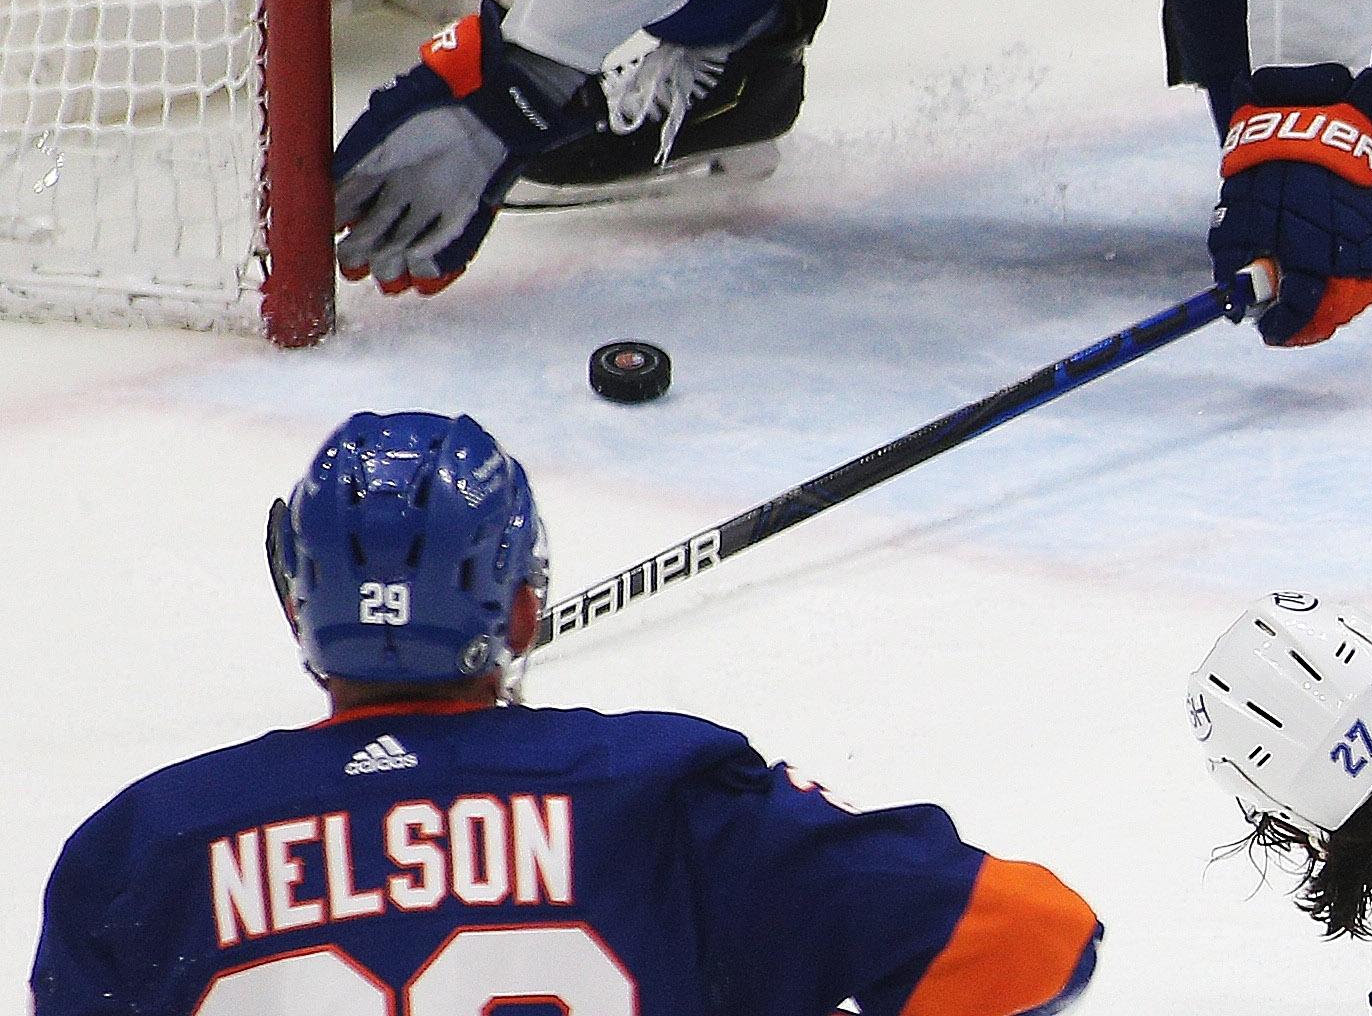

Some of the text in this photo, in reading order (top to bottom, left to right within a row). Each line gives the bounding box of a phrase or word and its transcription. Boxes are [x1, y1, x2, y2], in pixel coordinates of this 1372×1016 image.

[359, 581, 410, 627] 29
[344, 753, 418, 776] adidas
[209, 792, 573, 949] NELSON
